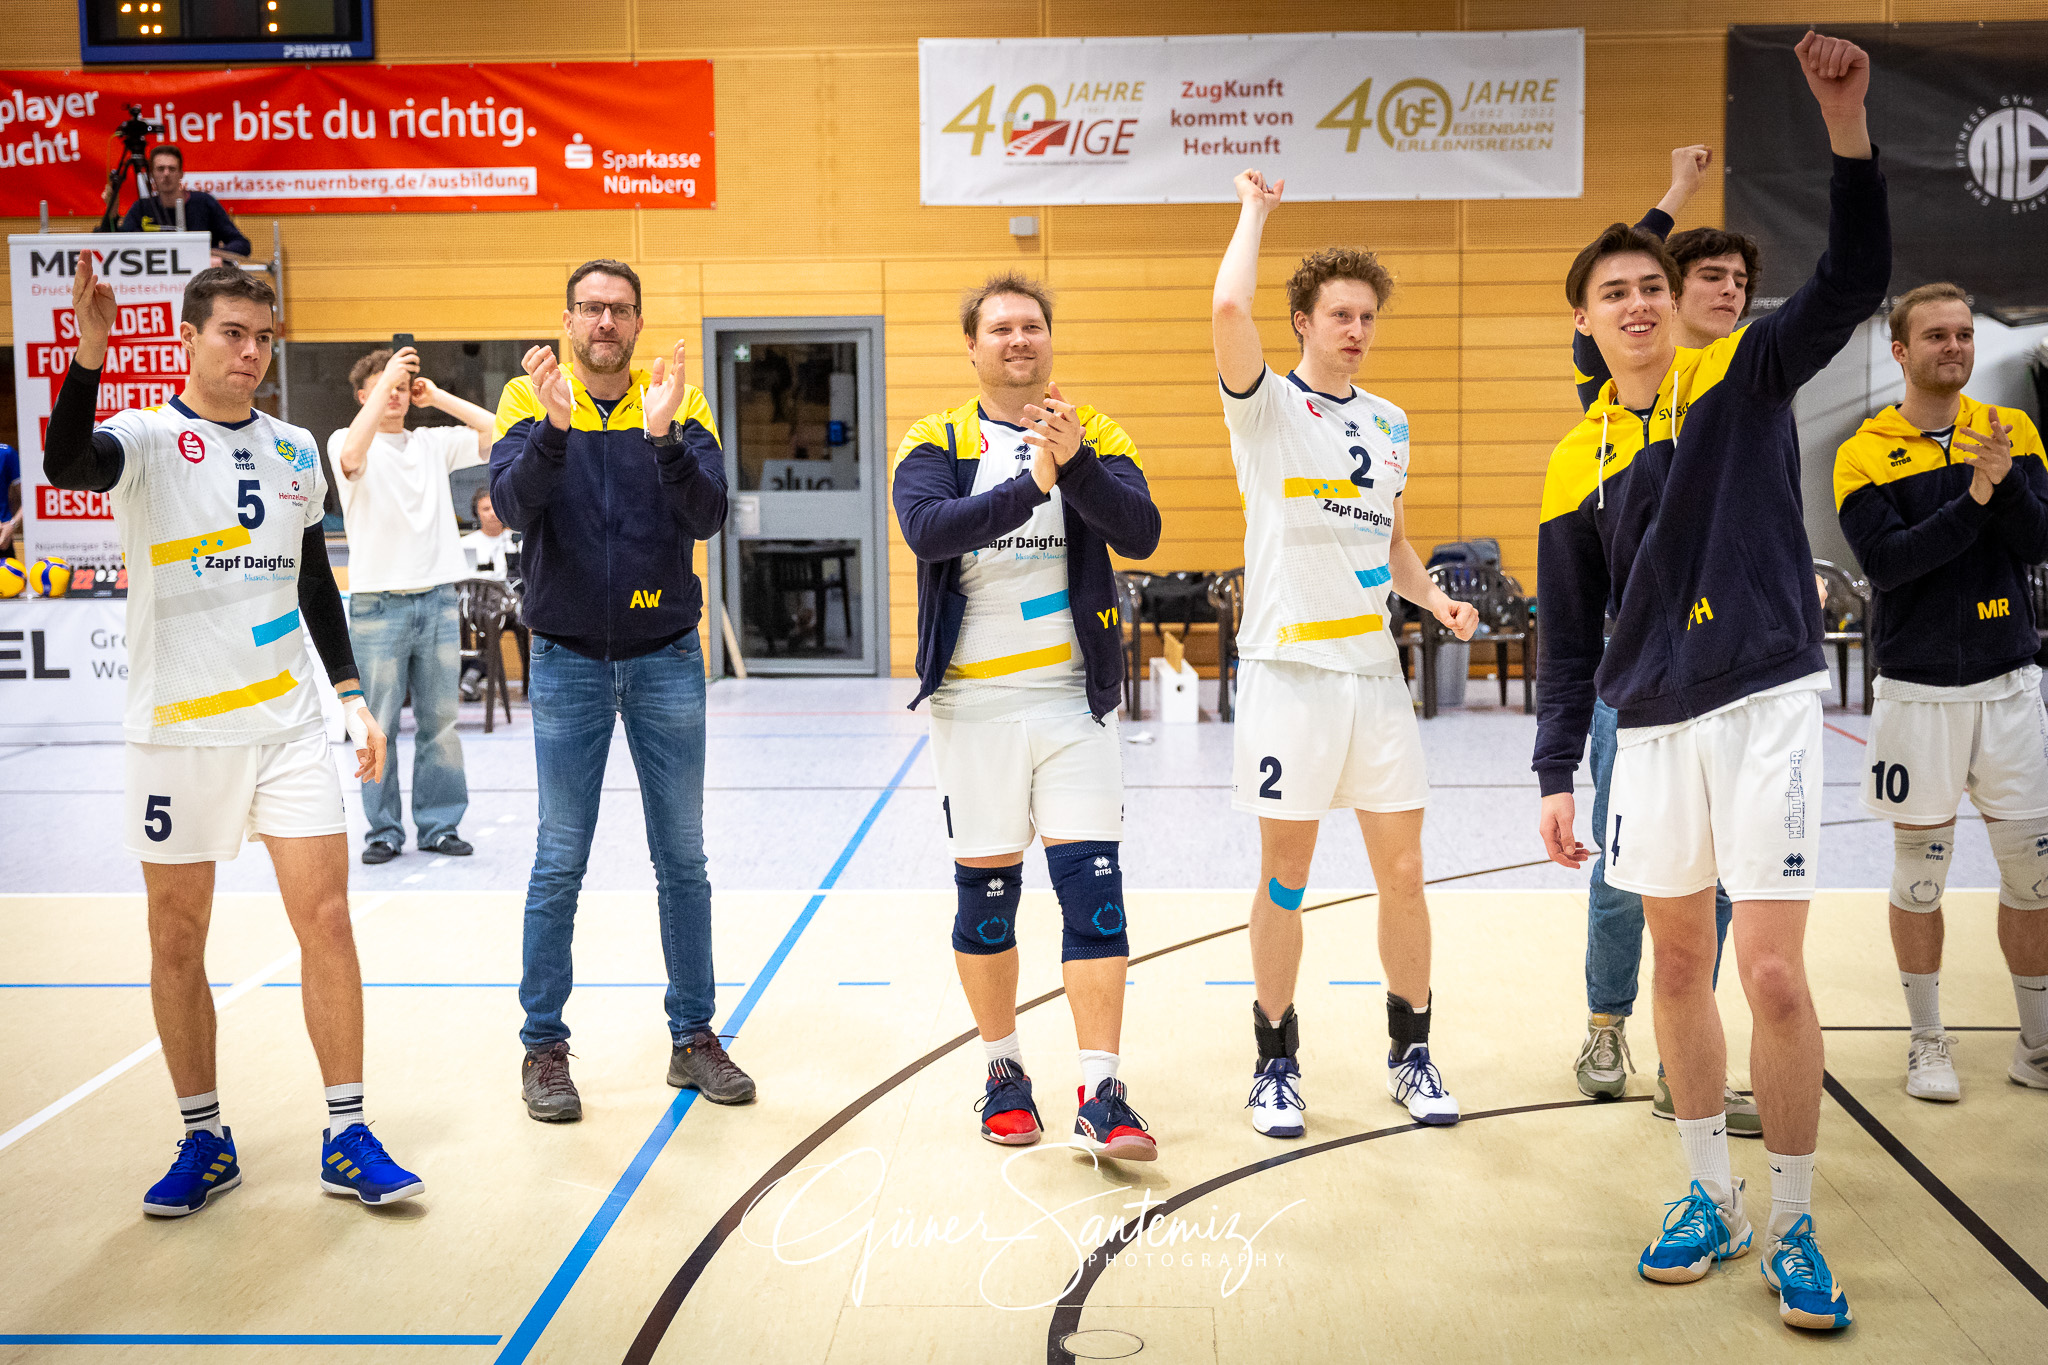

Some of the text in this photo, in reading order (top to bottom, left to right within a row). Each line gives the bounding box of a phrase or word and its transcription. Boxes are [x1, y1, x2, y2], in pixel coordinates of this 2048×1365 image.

[283, 44, 352, 58] PEWETA
[1181, 79, 1284, 103] ZugKunft
[1459, 78, 1559, 112] JAHRE
[0, 89, 99, 132] player
[233, 100, 313, 141] bist
[322, 98, 376, 139] du
[389, 97, 537, 147] richtig.
[941, 81, 1146, 156] 40 JAHRE
[1171, 109, 1294, 128] kommt von
[1069, 119, 1138, 156] IGE
[1452, 121, 1555, 136] EISENBAHN
[1184, 136, 1281, 155] Herkunft
[1396, 137, 1553, 152] ERLEBNISREISEN
[602, 149, 701, 172] Sparkasse
[603, 174, 696, 197] Nürnberg
[30, 248, 192, 277] MEYSEL
[37, 344, 188, 375] FOTAPETEN
[235, 462, 256, 471] errea
[1348, 445, 1374, 489] 2
[1890, 455, 1912, 467] errea
[237, 479, 265, 530] 5
[1323, 498, 1352, 517] Zapf
[984, 537, 1013, 551] apf
[205, 555, 241, 571] Zapf
[630, 590, 662, 608] AW
[1977, 598, 2010, 620] MR
[1259, 756, 1282, 800] 2
[1871, 760, 1910, 804] 10
[144, 794, 172, 842] 5
[1783, 868, 1805, 877] errea
